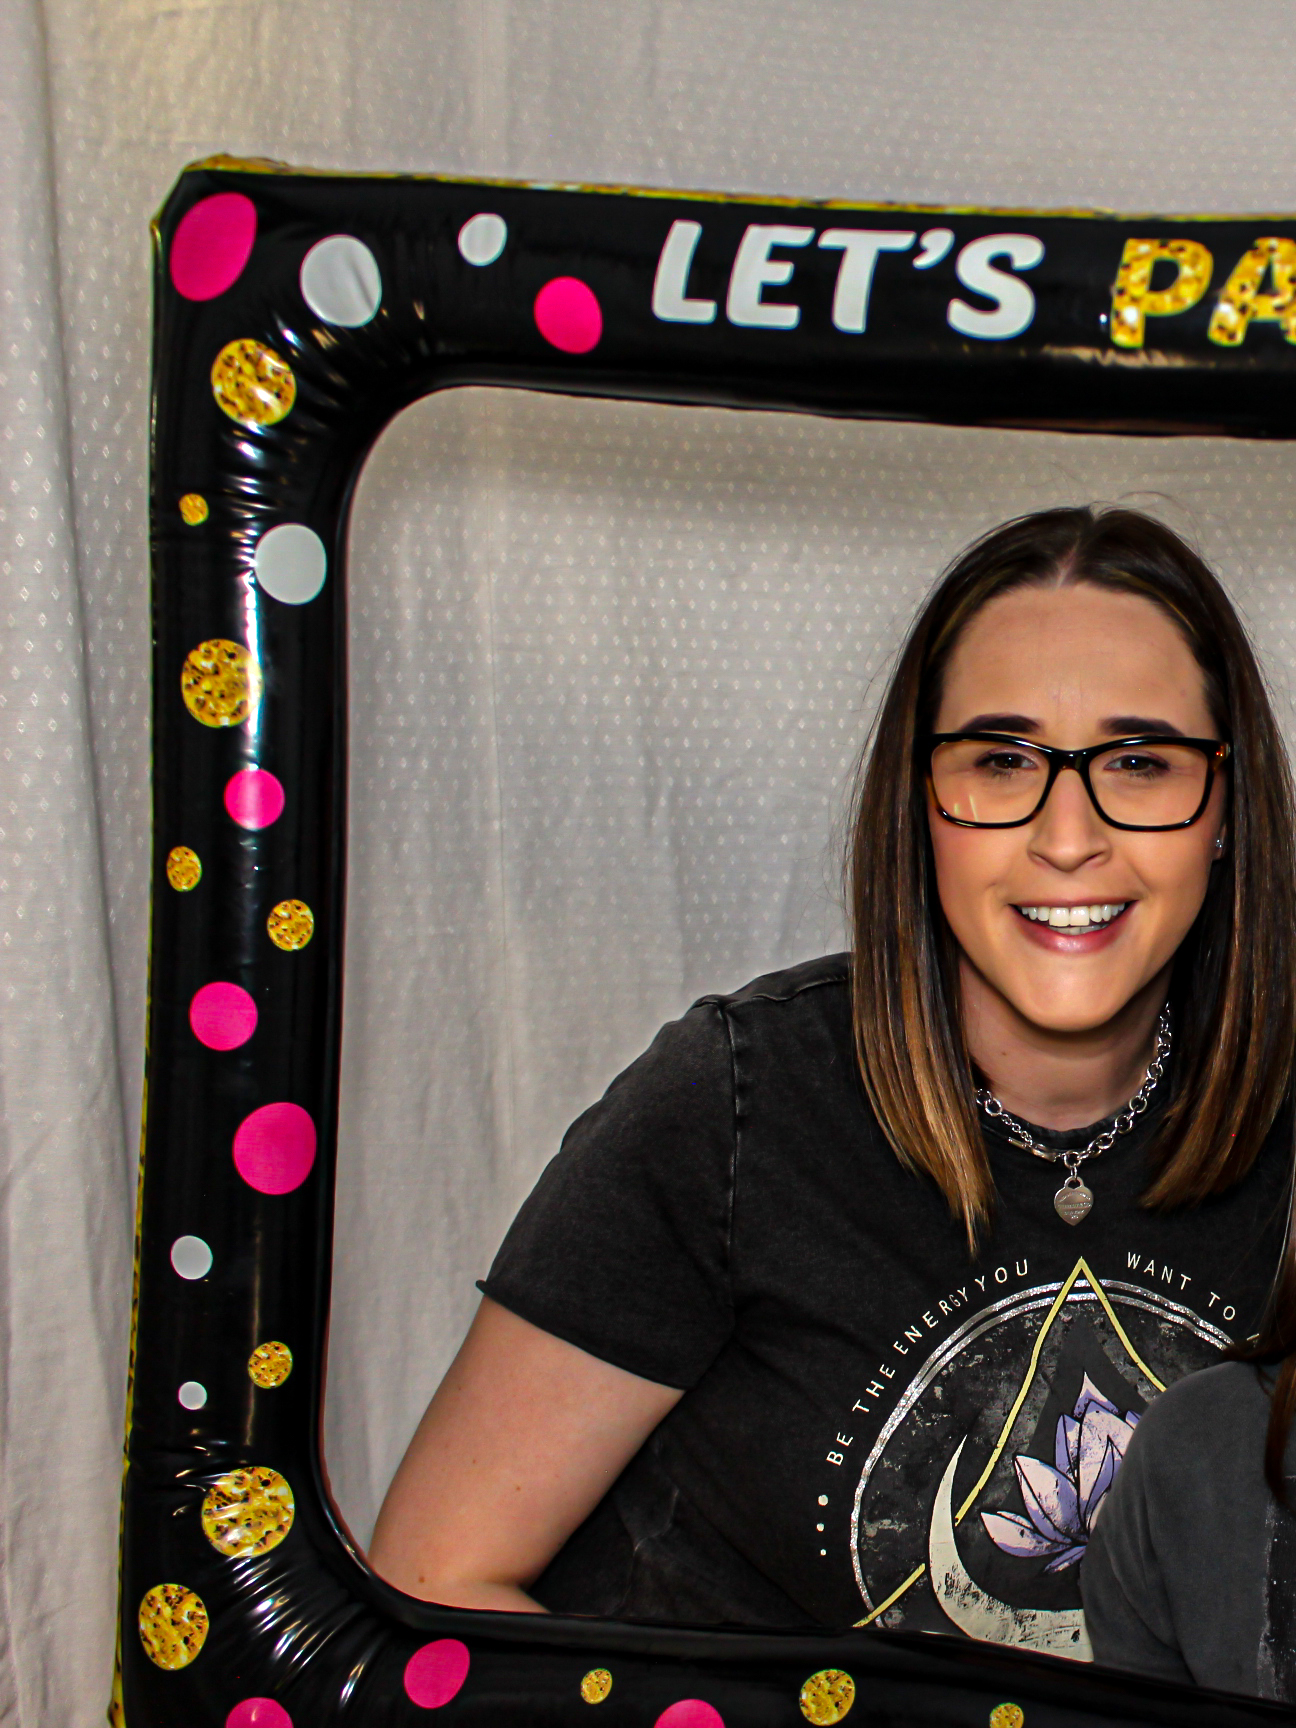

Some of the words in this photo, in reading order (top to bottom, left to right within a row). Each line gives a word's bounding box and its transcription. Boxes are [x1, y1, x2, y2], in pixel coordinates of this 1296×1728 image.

[651, 218, 1045, 340] LET'S
[825, 1431, 854, 1467] BE
[851, 1363, 896, 1414] THE
[892, 1286, 969, 1356] ENERGY
[974, 1258, 1028, 1292] YOU
[1127, 1251, 1192, 1291] WANT
[1208, 1291, 1236, 1321] TO
